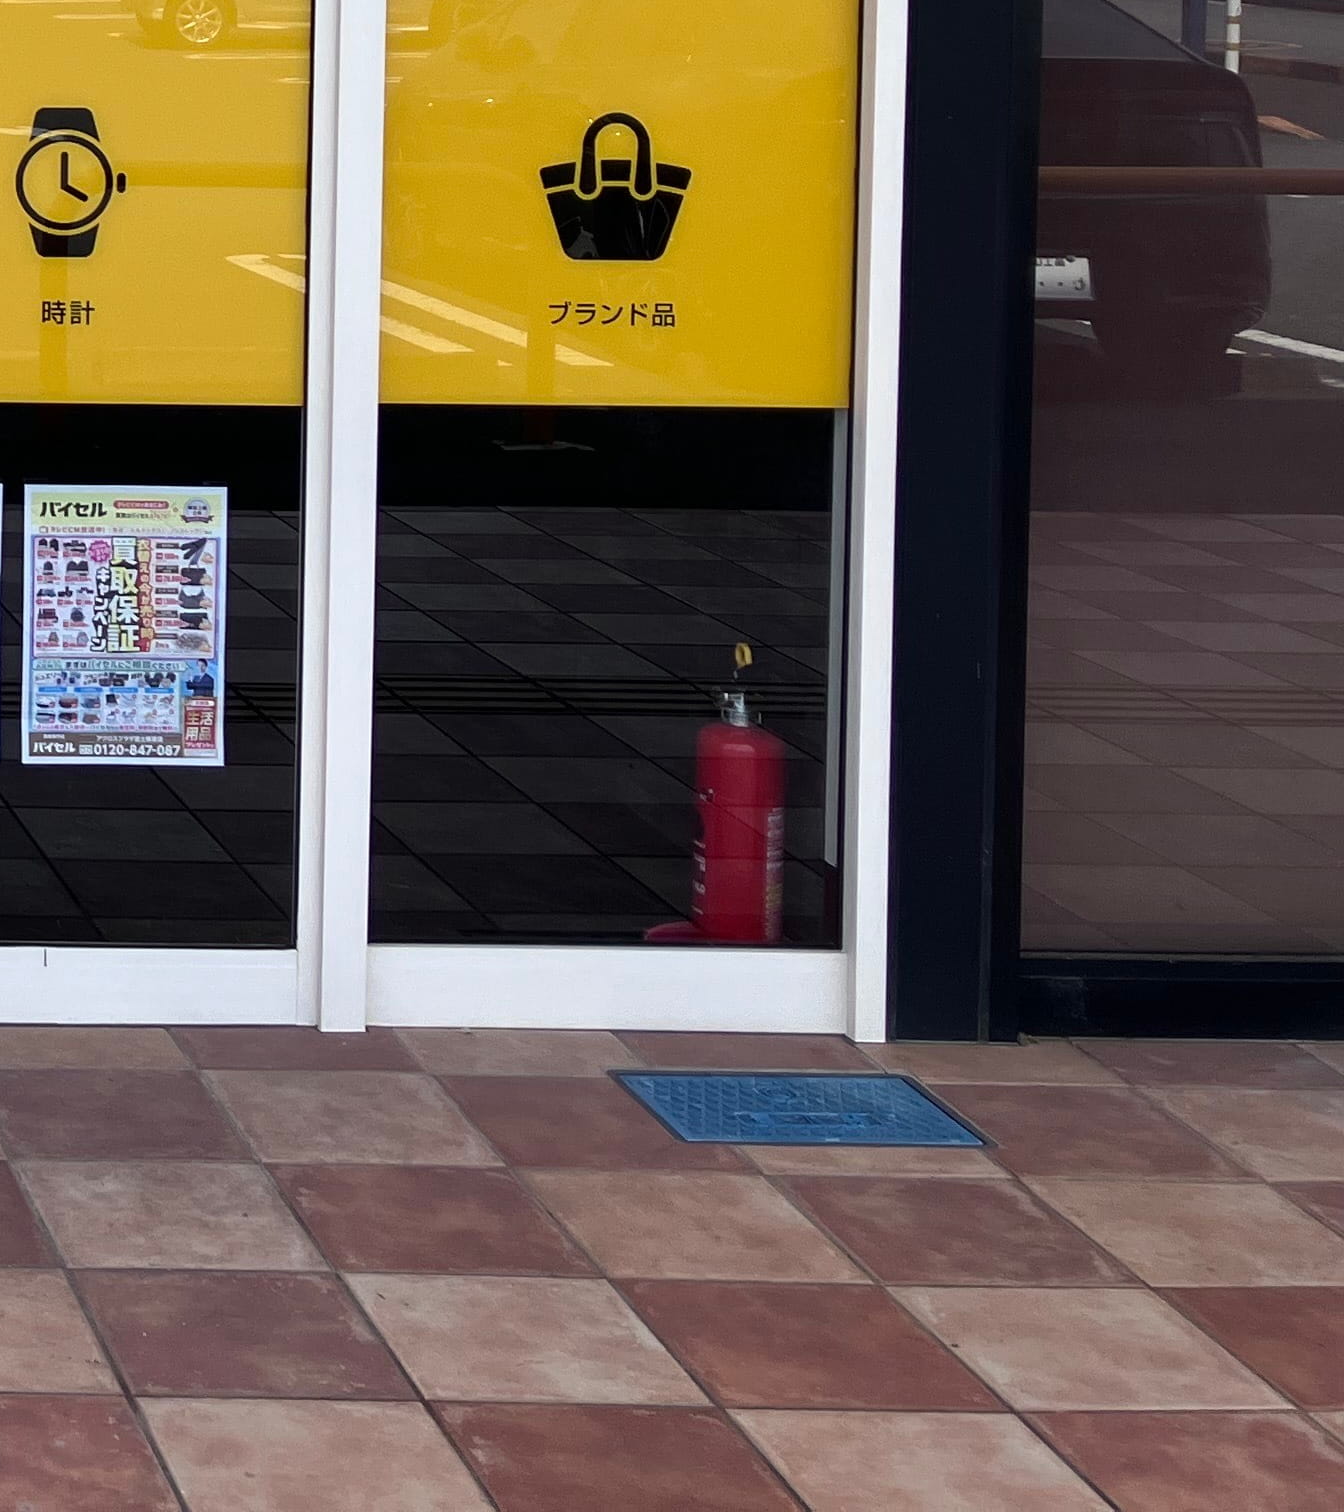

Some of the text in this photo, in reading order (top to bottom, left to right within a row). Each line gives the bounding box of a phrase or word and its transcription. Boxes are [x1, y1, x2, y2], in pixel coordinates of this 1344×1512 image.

[40, 300, 96, 326] 時計
[548, 301, 676, 328] ブランド品
[39, 501, 108, 518] バイセル
[107, 537, 140, 652] 買取保証
[32, 742, 181, 756] バイセル 0120-847-087
